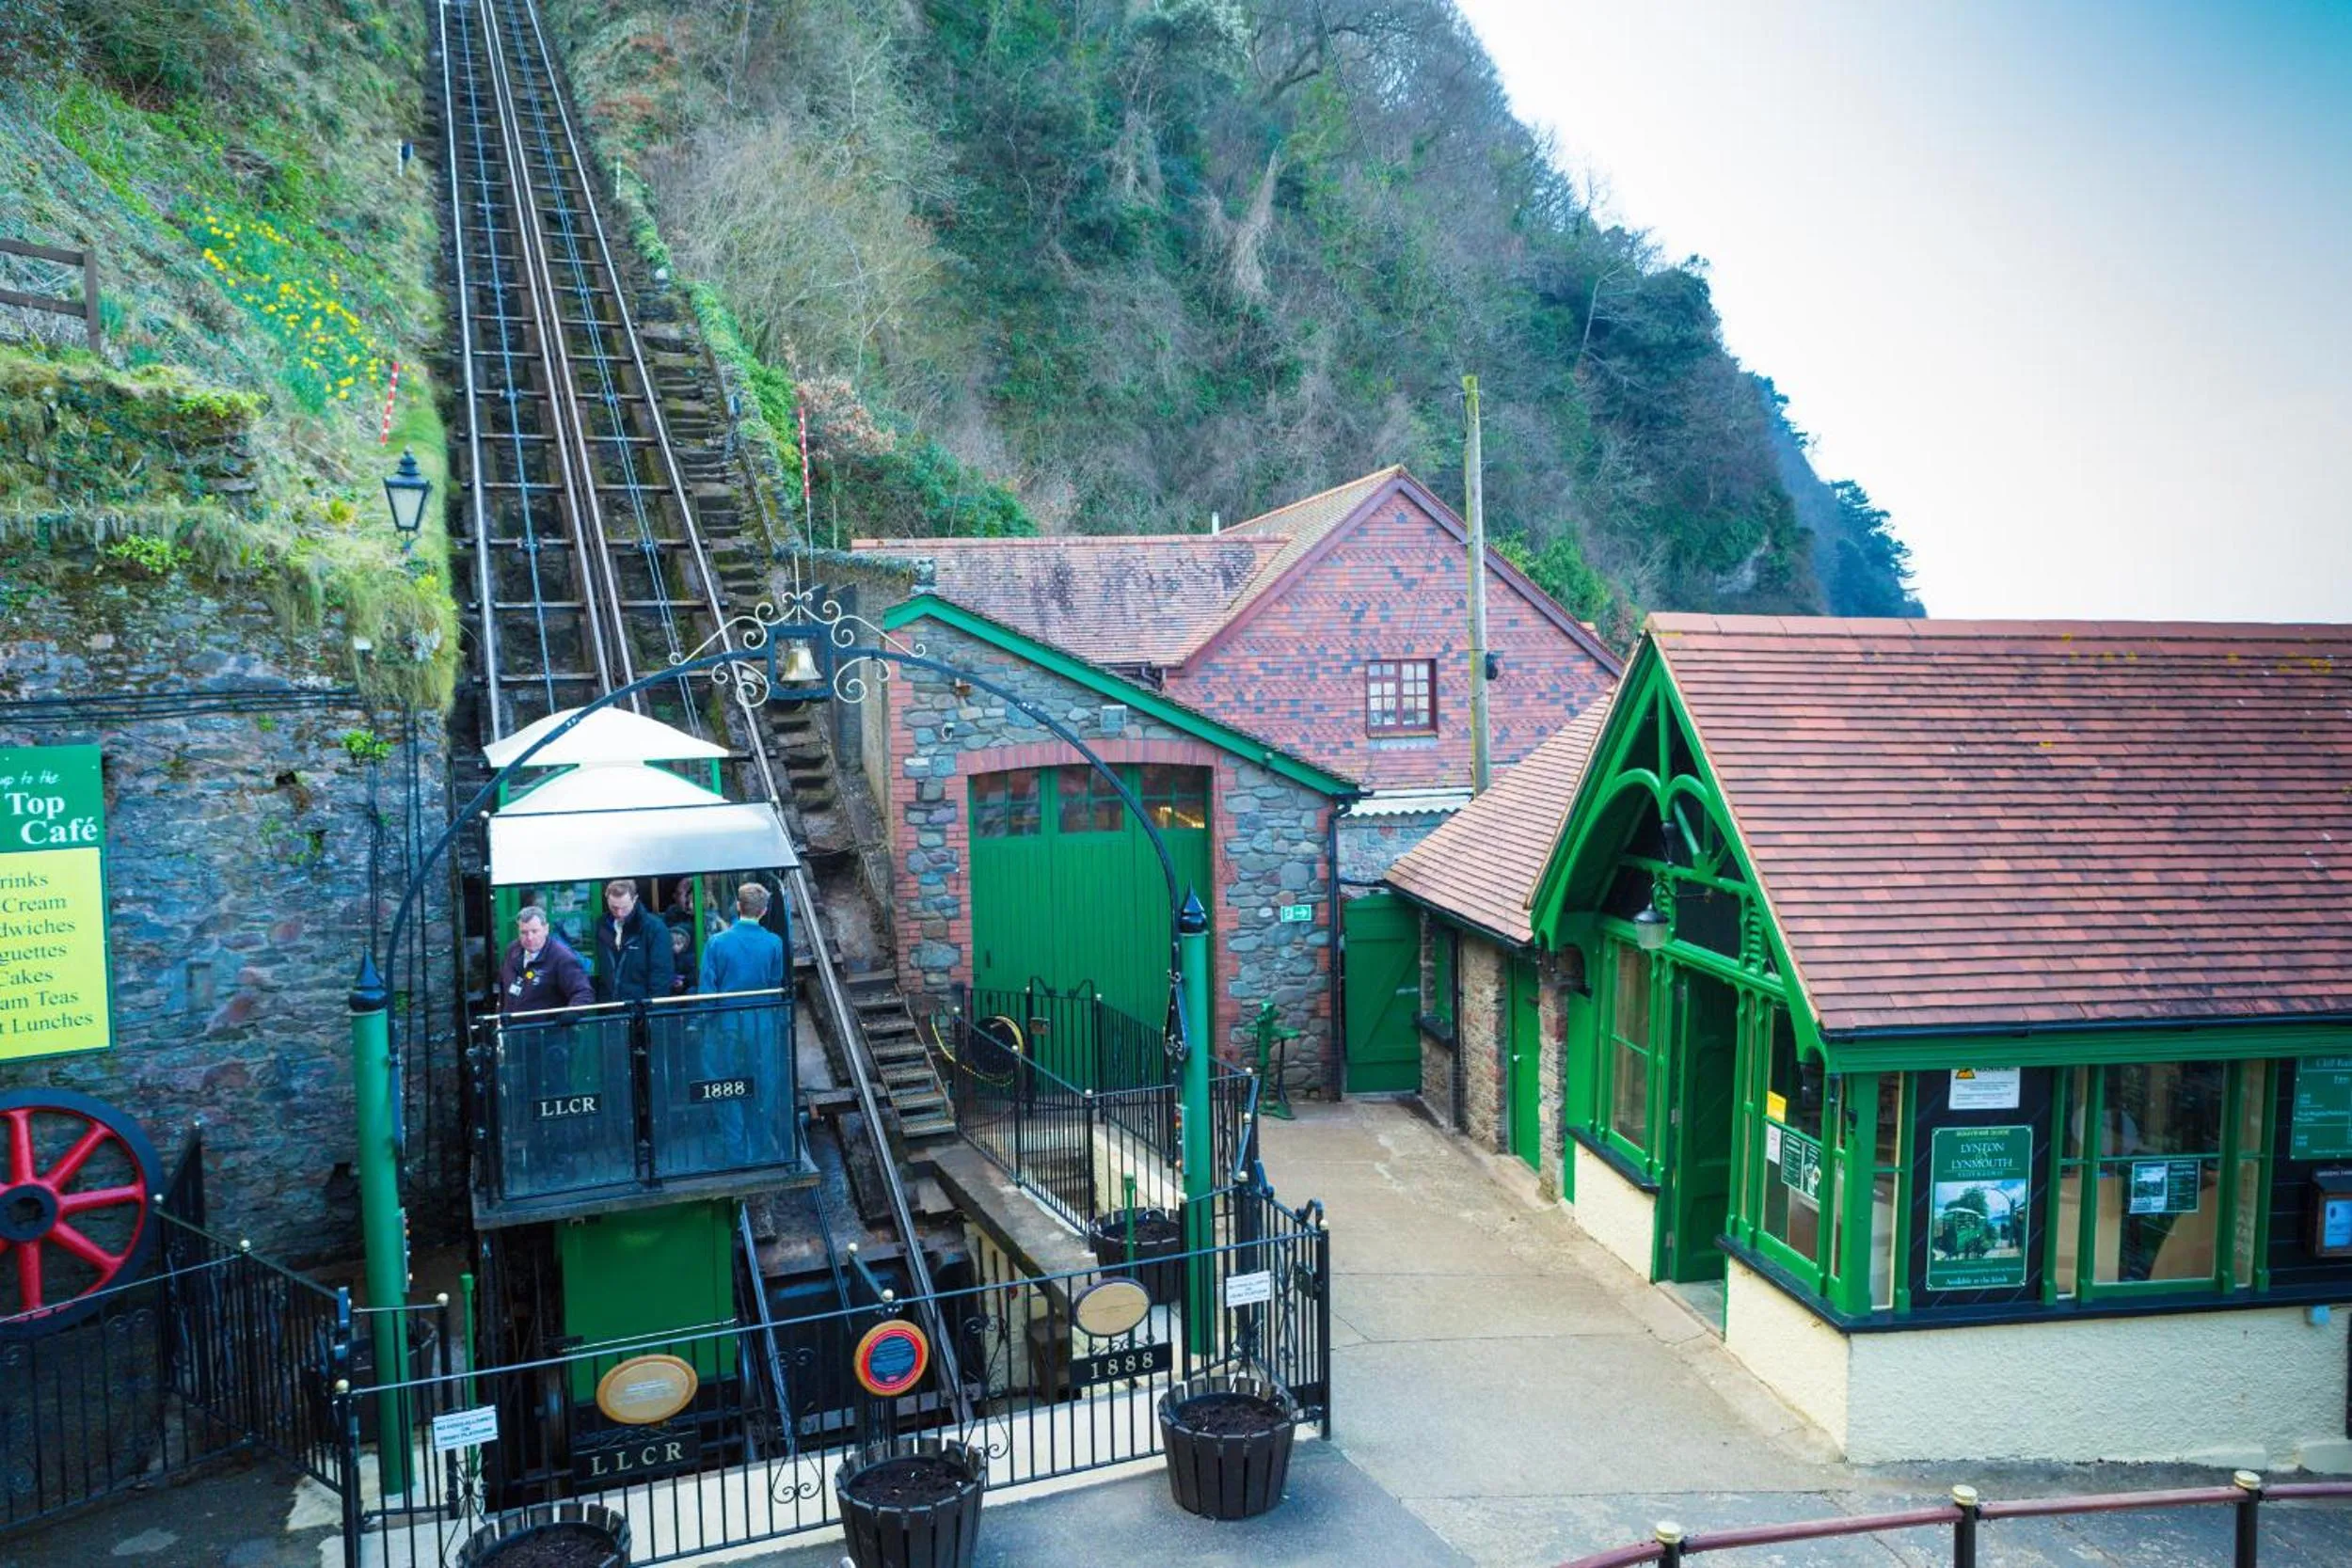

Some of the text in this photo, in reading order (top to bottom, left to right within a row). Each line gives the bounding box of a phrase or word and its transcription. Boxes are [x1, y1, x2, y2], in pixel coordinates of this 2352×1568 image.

[5, 792, 65, 819] Top
[21, 816, 98, 845] Café
[2, 896, 67, 913] Cream
[36, 990, 79, 1007] Teas
[13, 1012, 94, 1034] Lunches
[703, 1081, 745, 1100] 1888
[541, 1097, 596, 1117] LLCR
[1960, 1142, 2005, 1153] LYNTON
[1951, 1158, 2012, 1170] LYNMOUTH
[1090, 1351, 1153, 1380] 1888
[591, 1442, 683, 1476] LLCR
